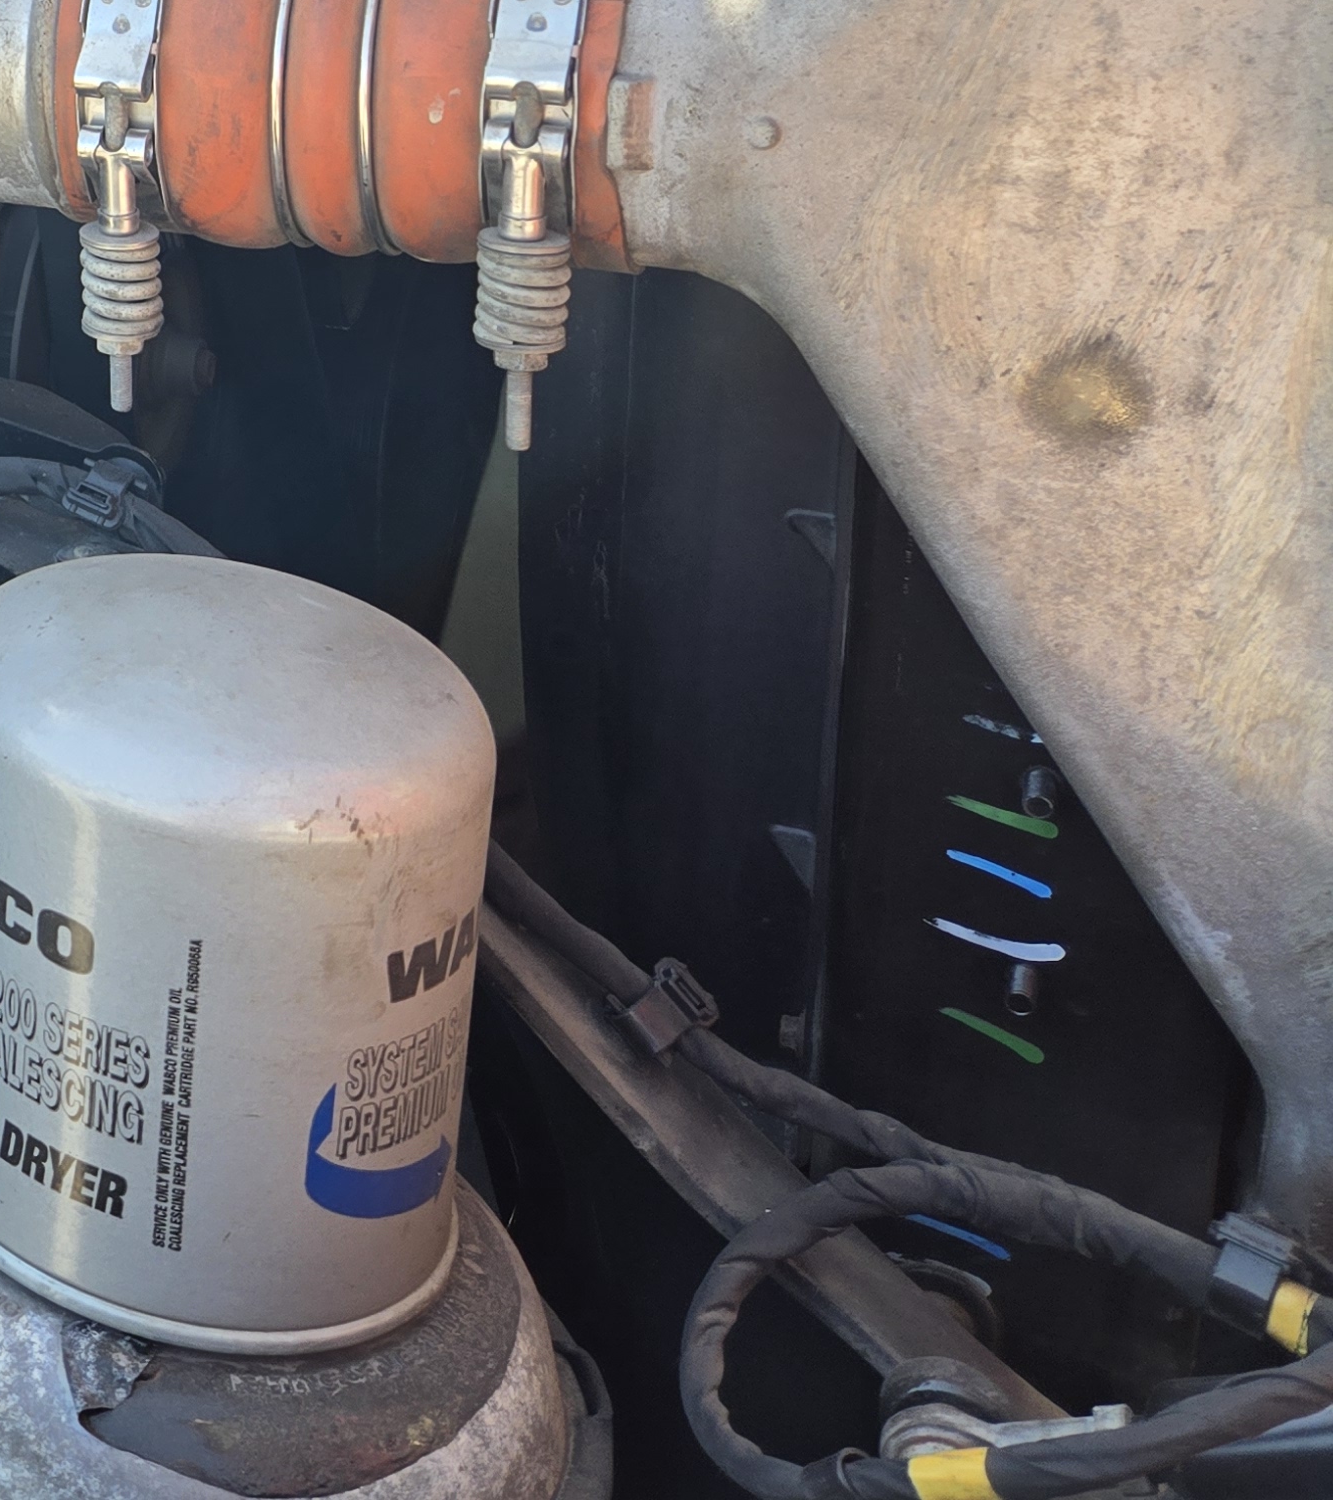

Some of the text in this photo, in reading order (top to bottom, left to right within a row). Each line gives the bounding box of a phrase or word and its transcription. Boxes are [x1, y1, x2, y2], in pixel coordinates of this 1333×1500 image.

[182, 1014, 198, 1045] PART
[183, 994, 199, 1015] NO.
[43, 1002, 151, 1090] SERIES
[178, 1043, 195, 1108] CARTRIDGE
[345, 1016, 446, 1102] SYSTEM
[152, 987, 183, 1249] SERVICE ONLY WITH GENUINE WABCO PREMIUM OIL
[172, 1111, 190, 1187] REPLACEMENT
[335, 1072, 451, 1160] PREMIUM
[0, 1118, 129, 1219] DRYER
[167, 1187, 186, 1252] COALESCING
